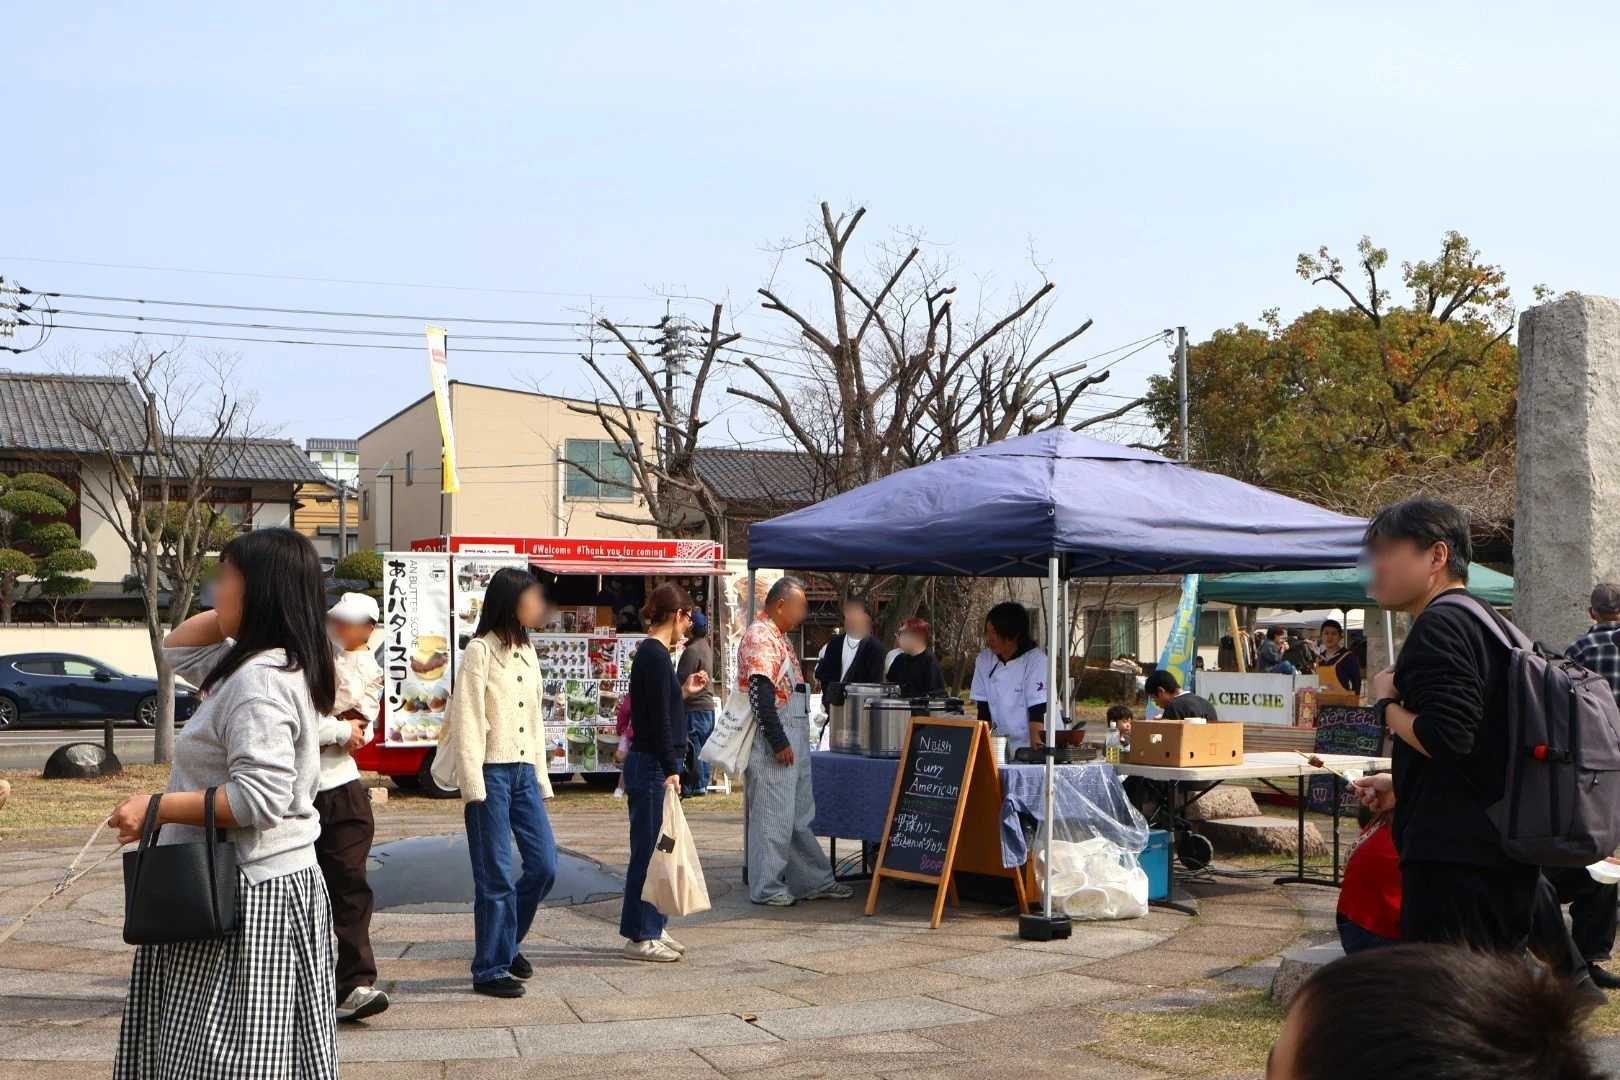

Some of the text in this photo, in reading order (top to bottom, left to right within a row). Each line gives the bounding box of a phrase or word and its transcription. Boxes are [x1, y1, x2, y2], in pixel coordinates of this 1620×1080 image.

[532, 544, 667, 558] #Welcome #Thank you for coming!
[409, 559, 420, 649] AN BUTTER SCONE
[388, 559, 408, 712] あんバタースコーン
[919, 735, 952, 752] Naish
[915, 757, 944, 778] Curry
[909, 776, 959, 797] American
